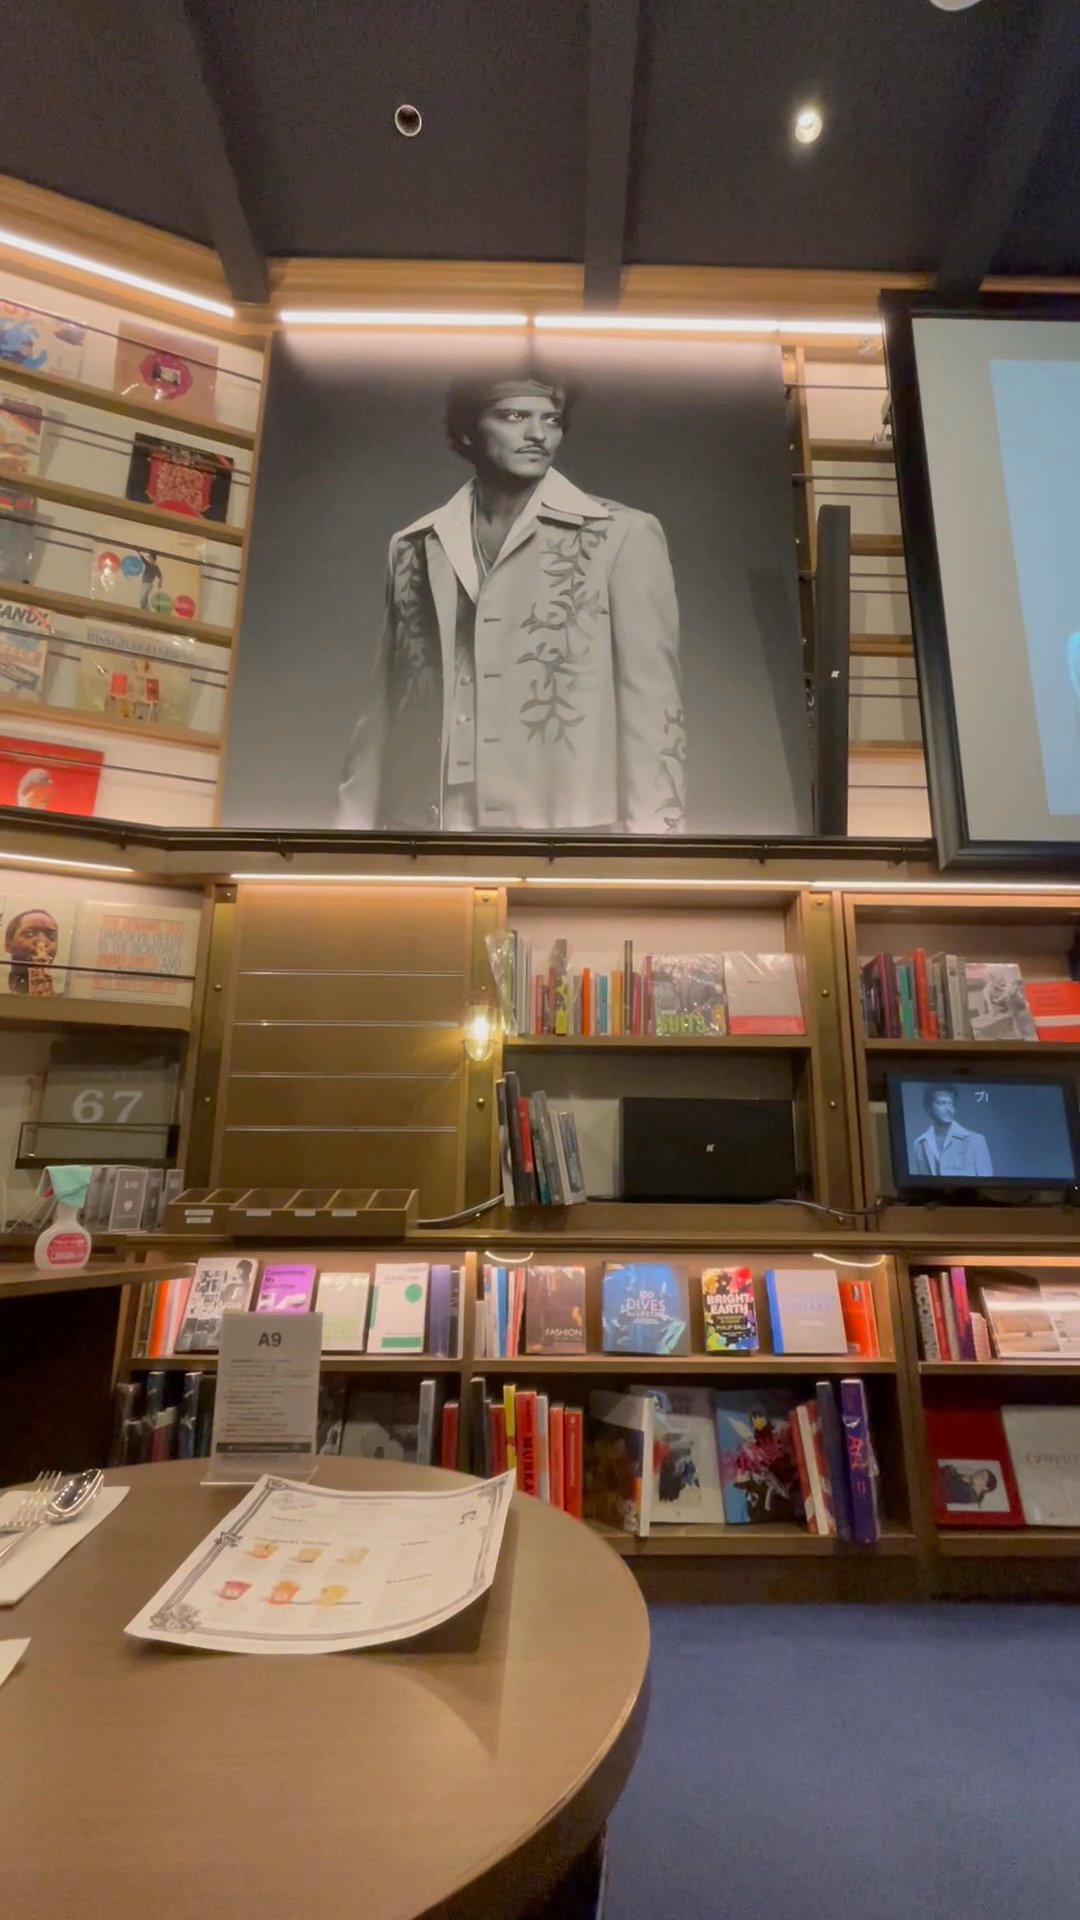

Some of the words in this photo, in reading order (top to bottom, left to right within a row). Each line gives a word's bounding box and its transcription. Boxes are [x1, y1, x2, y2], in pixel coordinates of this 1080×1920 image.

[72, 1088, 143, 1124] 67
[626, 1298, 666, 1312] DIVES
[706, 1293, 751, 1305] BRIGHT
[710, 1303, 749, 1317] EARTH
[545, 1328, 583, 1336] FASHION
[258, 1331, 282, 1348] A9
